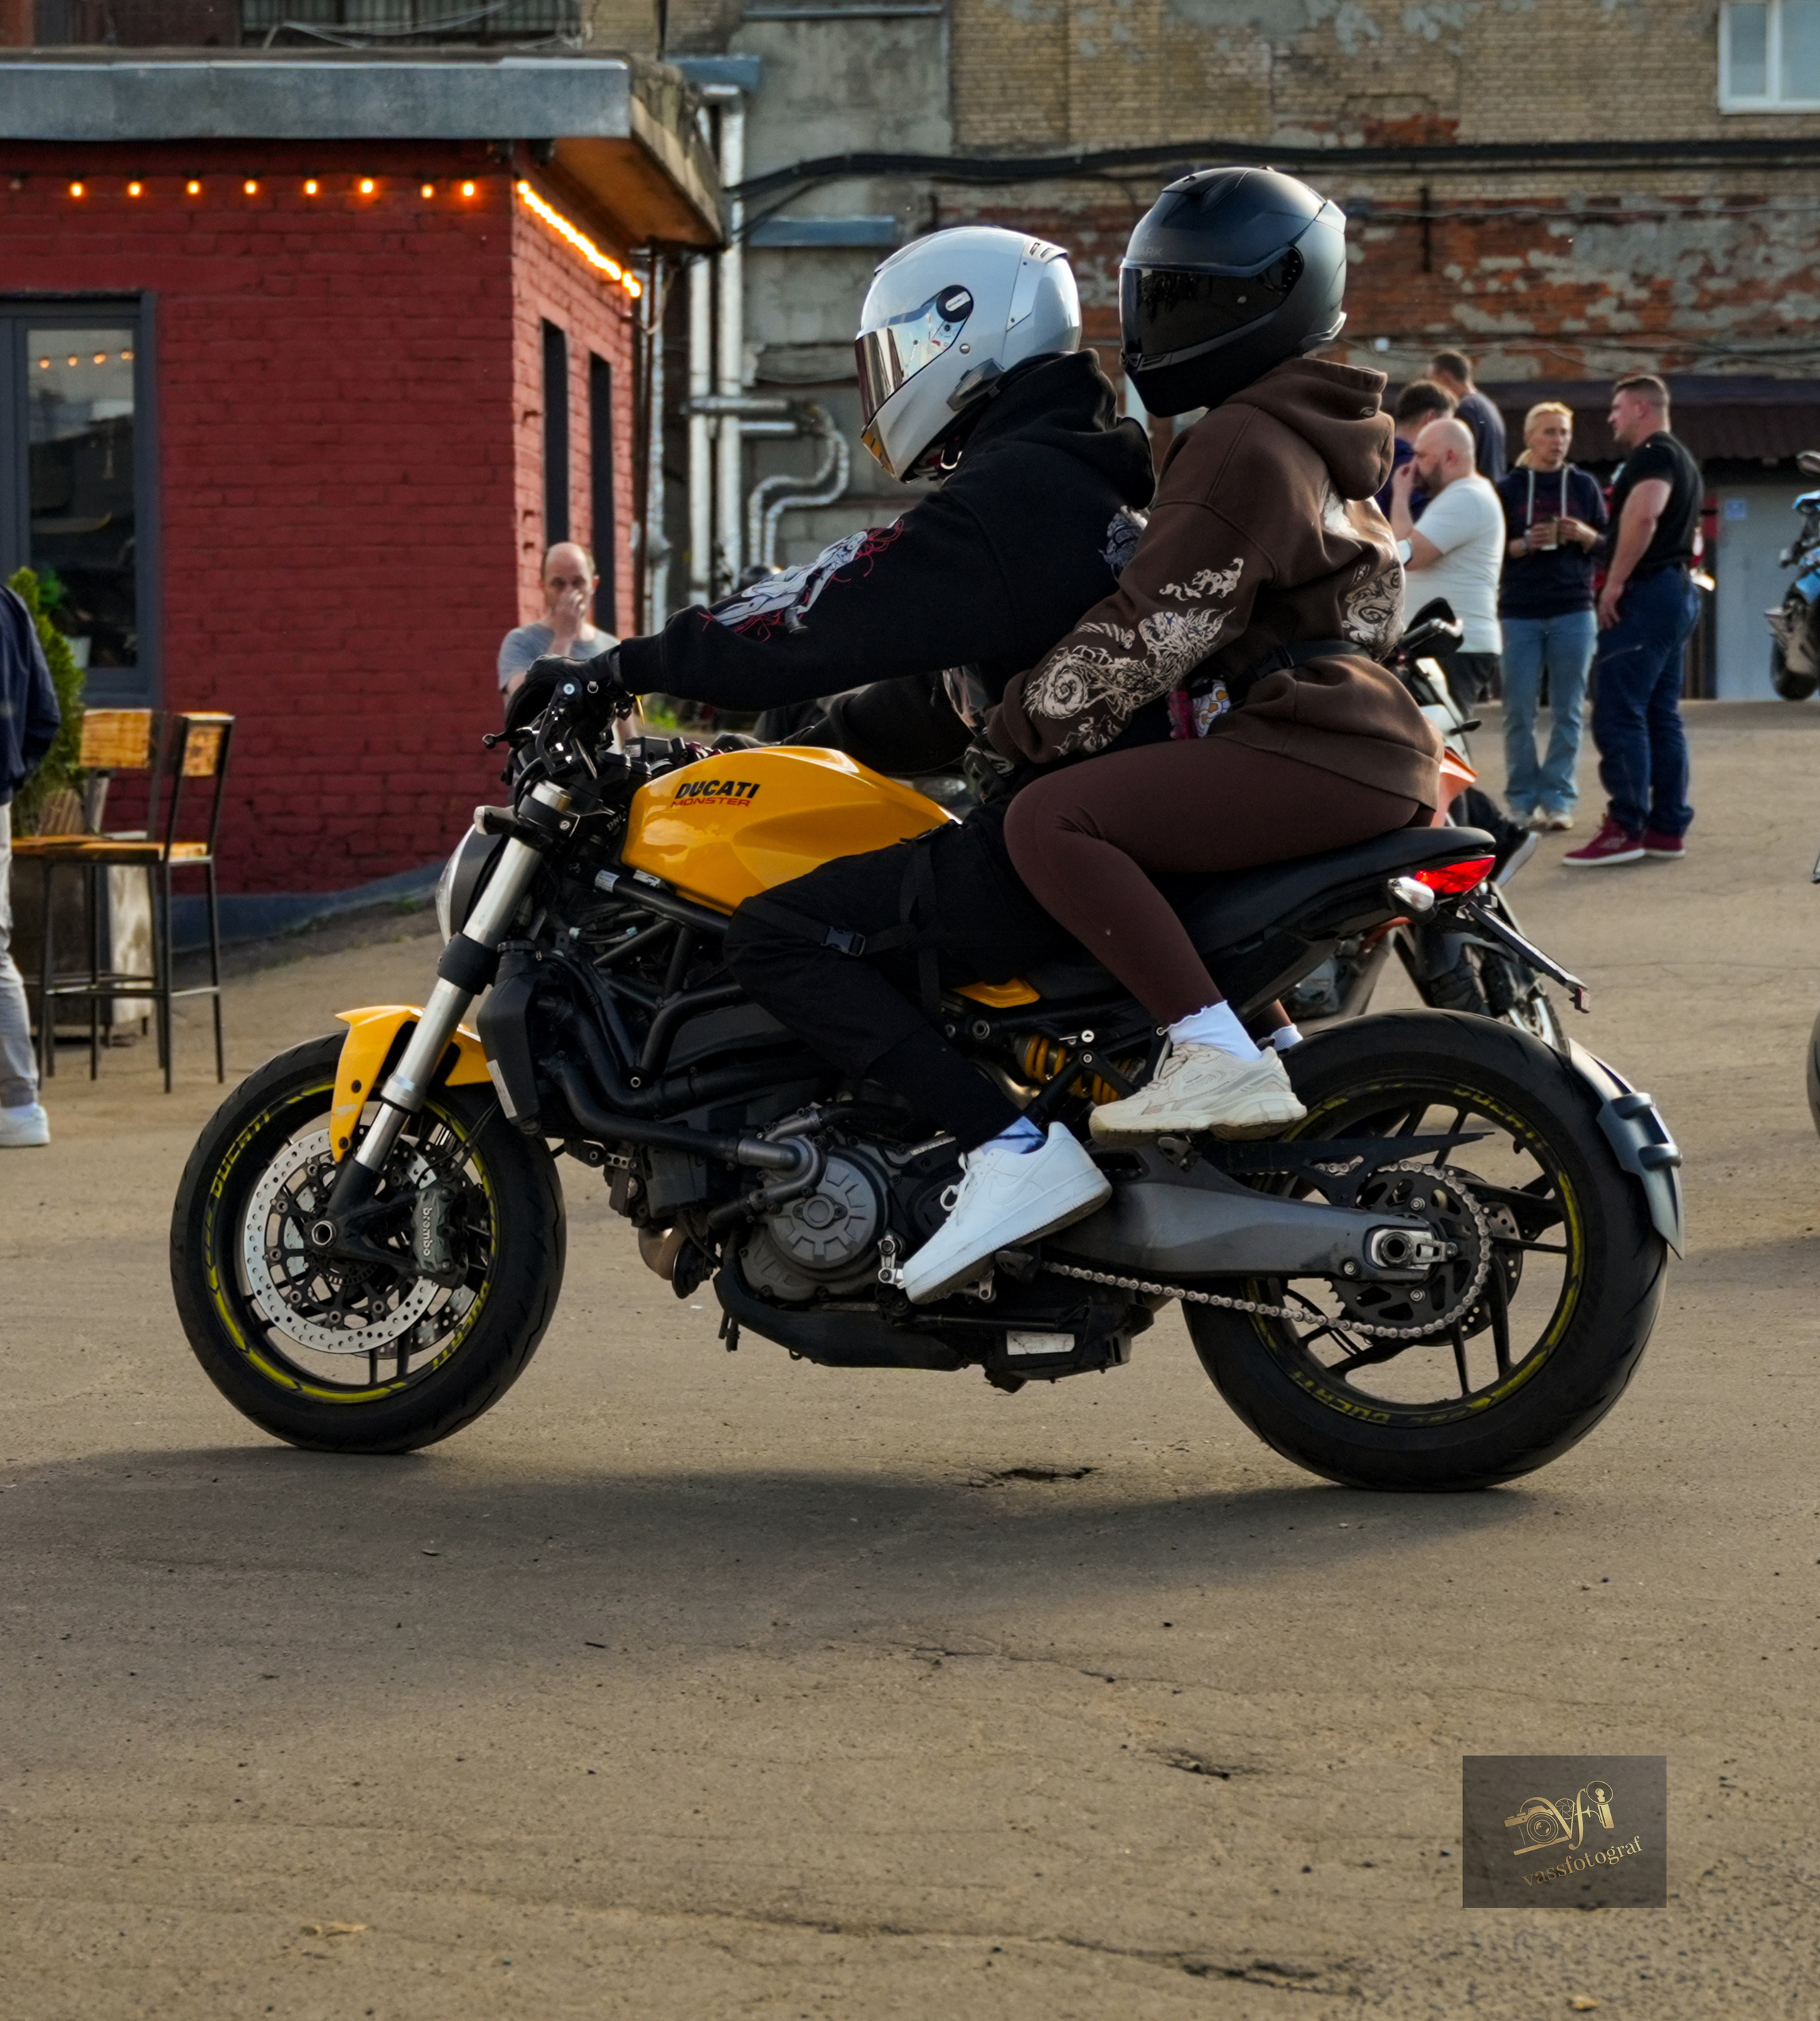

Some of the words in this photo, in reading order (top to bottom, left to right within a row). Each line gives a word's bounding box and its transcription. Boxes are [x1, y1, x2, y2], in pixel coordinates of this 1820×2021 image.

[670, 796, 751, 808] MONSTER
[675, 780, 761, 799] DUCATI
[210, 1109, 271, 1199] DUCATI
[422, 1207, 433, 1257] brembo
